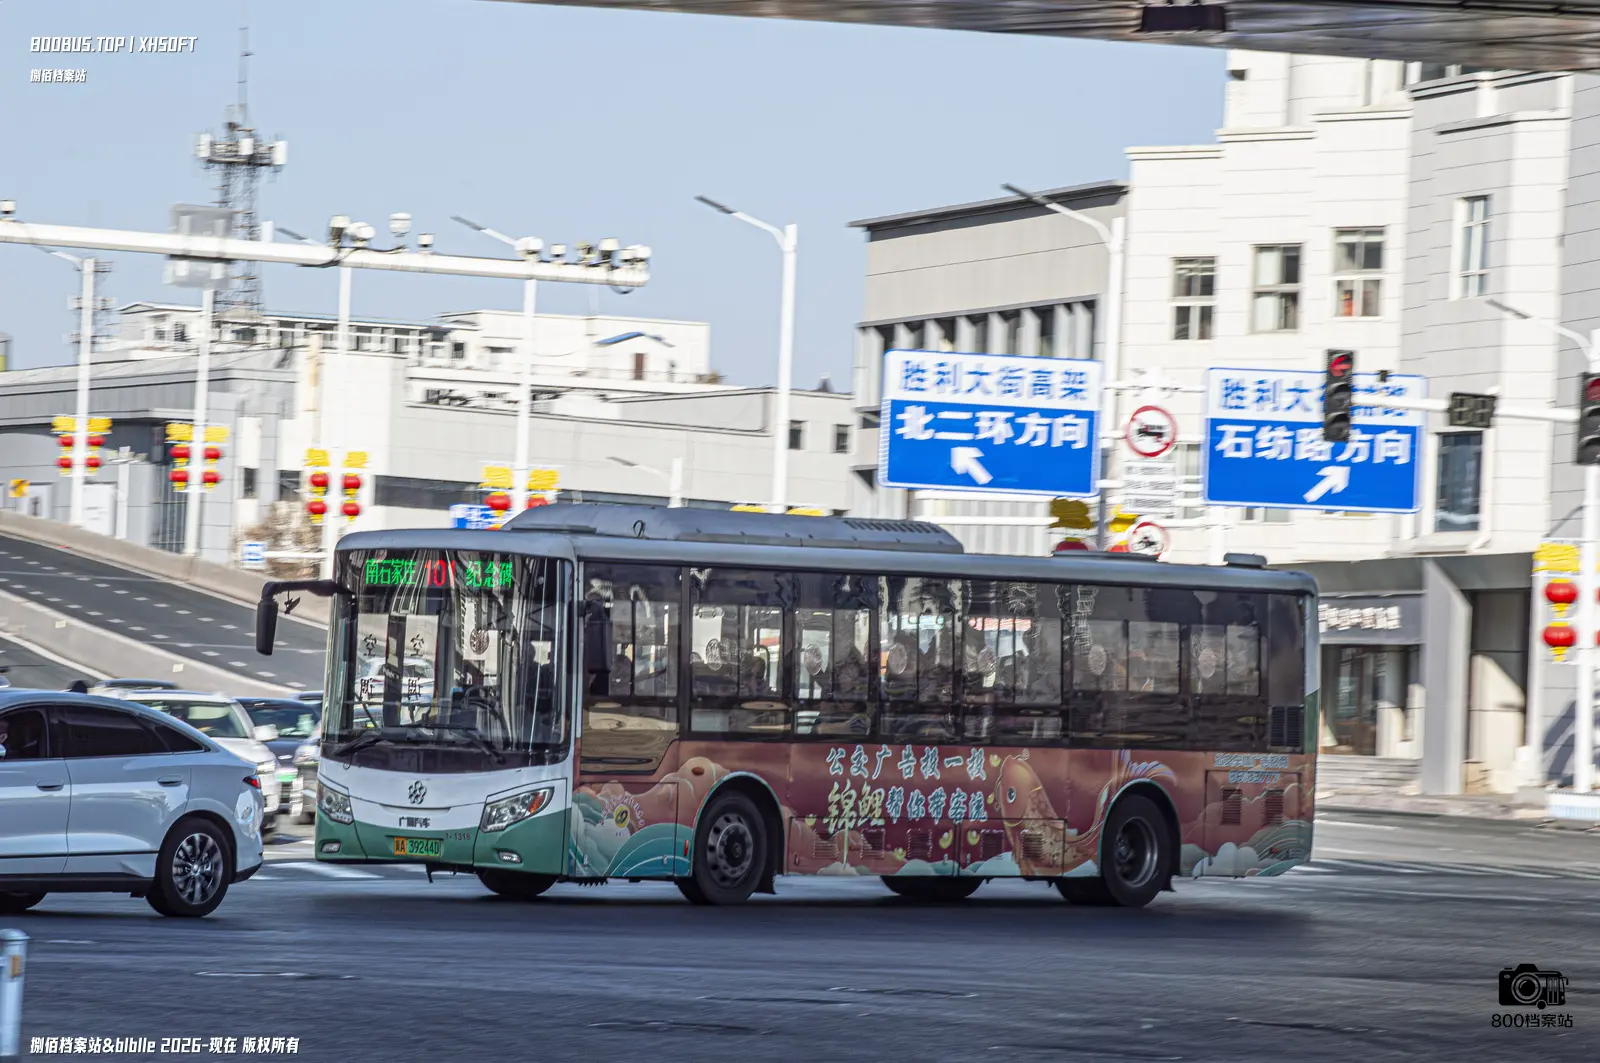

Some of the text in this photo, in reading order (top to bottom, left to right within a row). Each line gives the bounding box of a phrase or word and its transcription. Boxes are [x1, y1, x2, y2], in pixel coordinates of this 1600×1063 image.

[902, 360, 1089, 401] 胜利大街高架
[1220, 378, 1409, 418] 胜利大
[895, 405, 1090, 450] 北二环方向
[1215, 424, 1412, 465] 石纺路方向
[365, 558, 513, 588] 南石家庄 101 纪念碑
[825, 744, 987, 781] 公交广告投一投
